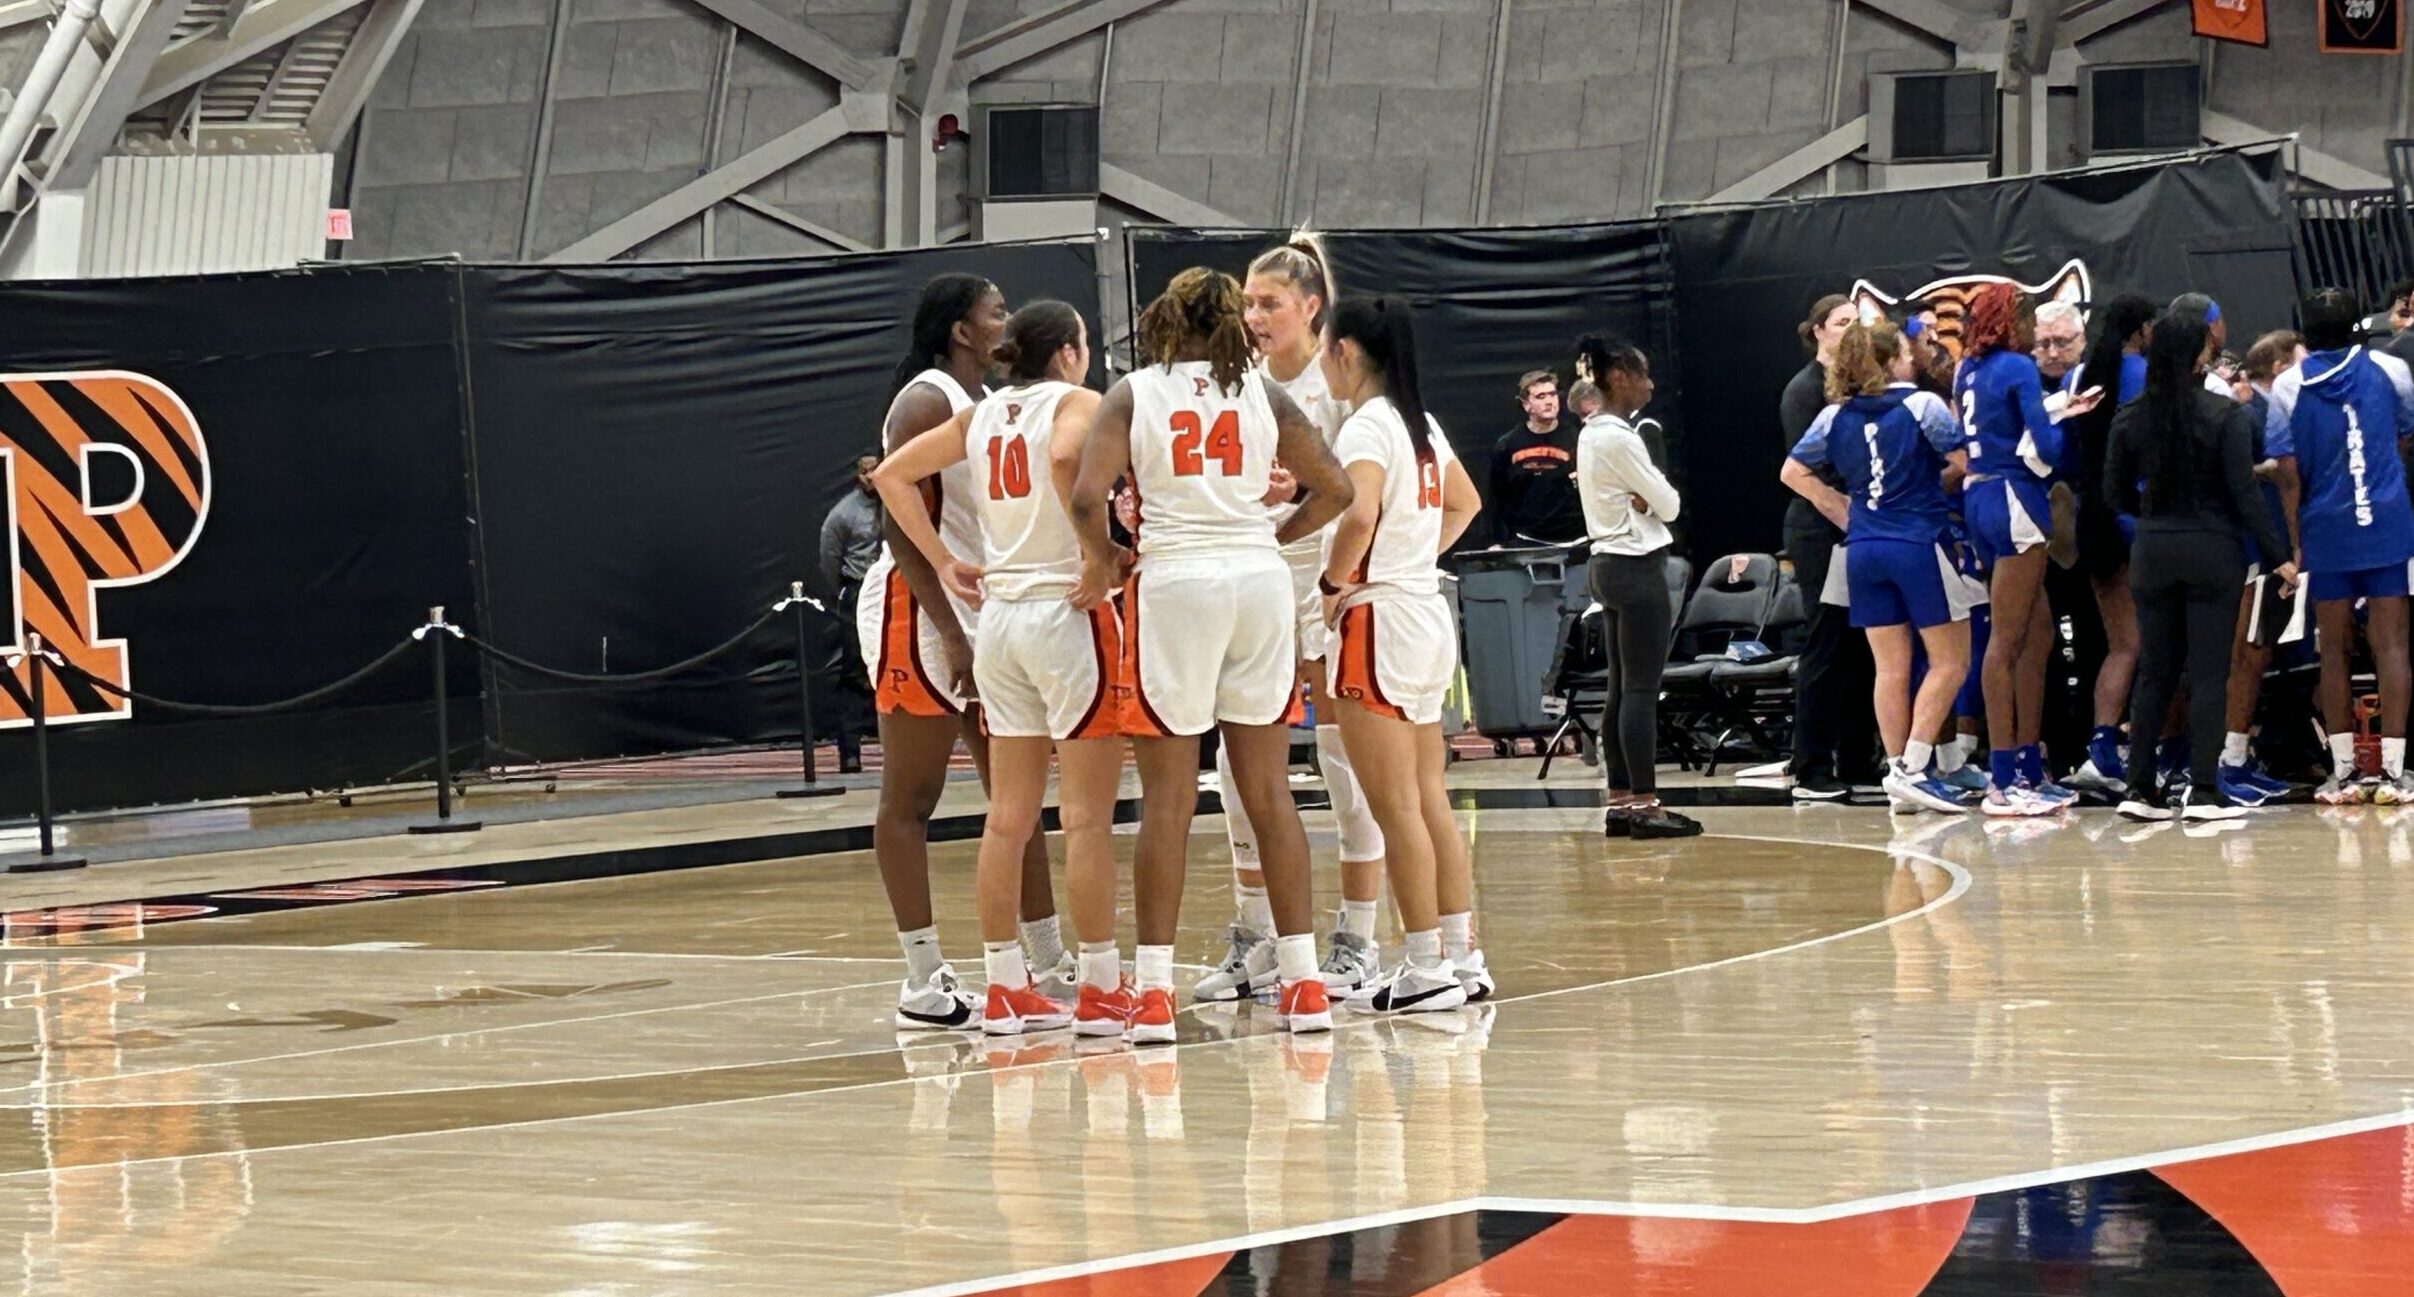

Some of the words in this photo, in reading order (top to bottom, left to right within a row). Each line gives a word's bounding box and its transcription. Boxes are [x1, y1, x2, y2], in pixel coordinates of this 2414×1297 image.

[1193, 377, 1210, 397] P
[1006, 403, 1022, 425] P
[1962, 389, 1977, 436] 2
[987, 433, 1032, 501] 10
[1169, 410, 1243, 477] 24
[0, 369, 212, 729] P
[890, 668, 909, 693] P
